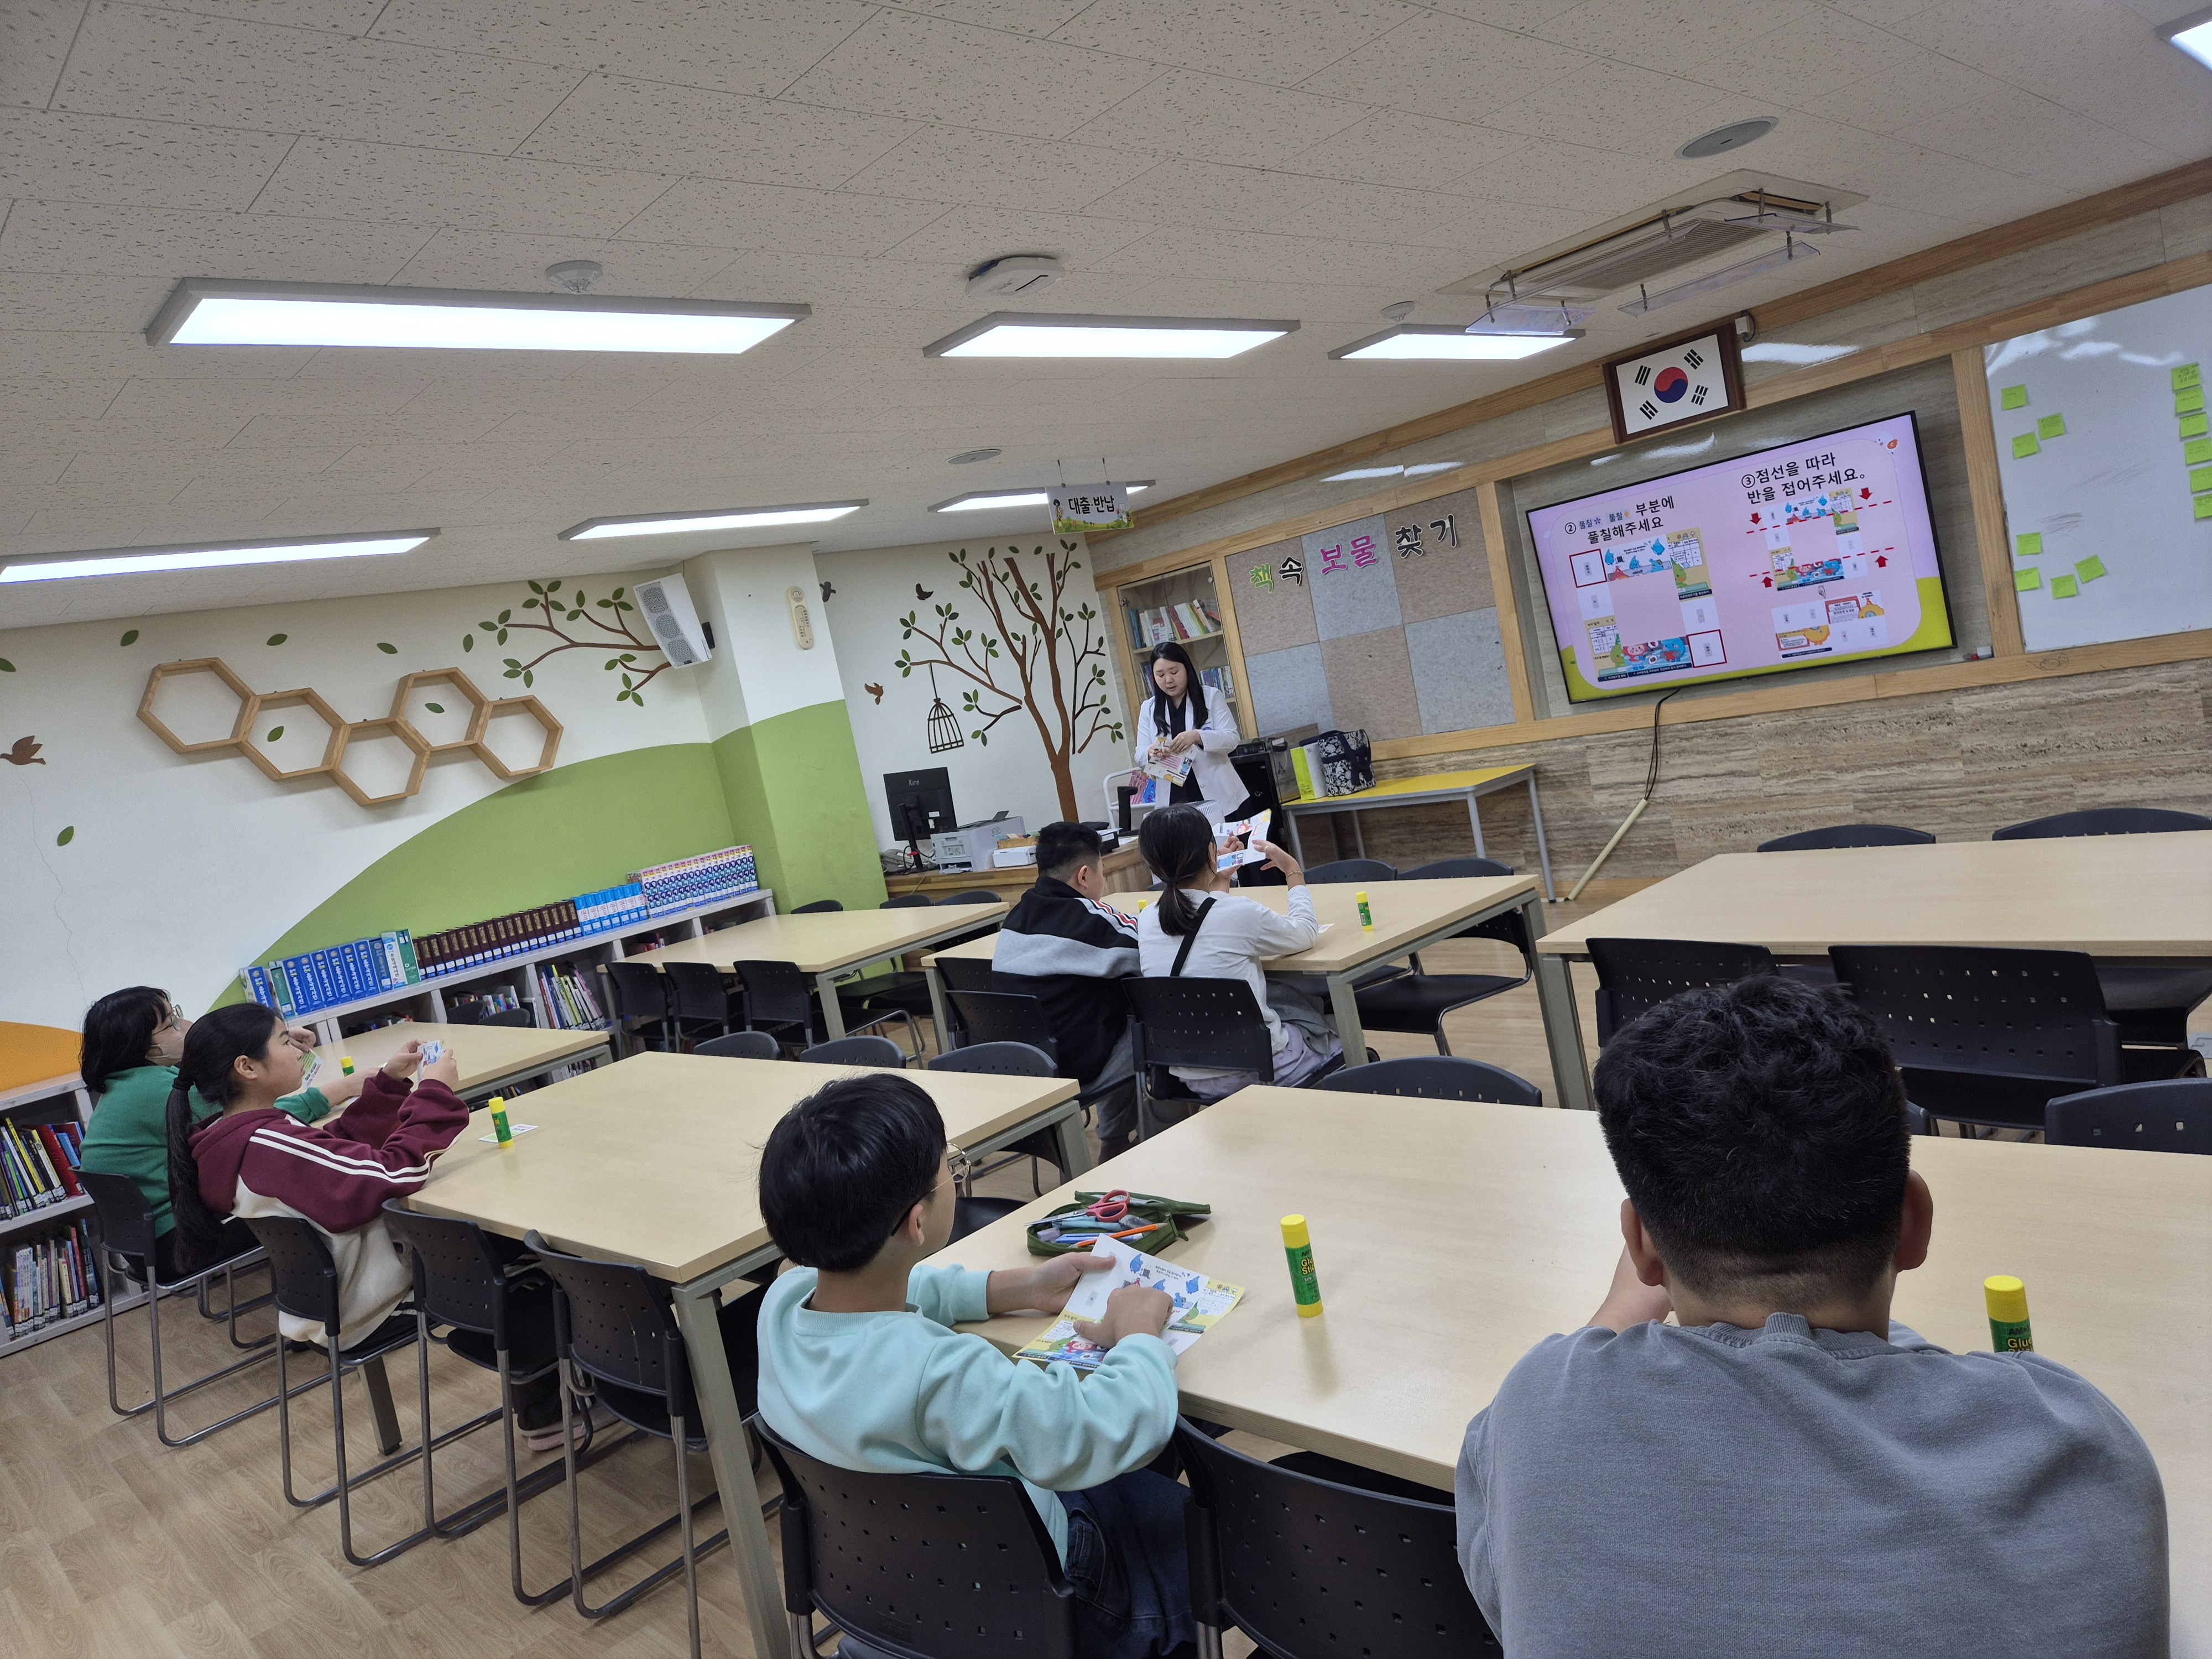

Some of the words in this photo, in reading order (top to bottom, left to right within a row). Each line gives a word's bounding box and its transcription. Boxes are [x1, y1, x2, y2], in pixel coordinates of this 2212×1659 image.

[1806, 452, 1835, 471] 따라
[1747, 486, 1776, 505] 반을
[1579, 519, 1593, 530] 풀칠
[1609, 512, 1624, 523] 풀칠
[1636, 495, 1674, 517] 부분에
[1587, 516, 1663, 545] 풀칠해주세요
[1250, 562, 1273, 593] 책
[1279, 556, 1303, 587] 속
[1319, 535, 1378, 576] 보물
[1394, 513, 1458, 560] 찾기
[2007, 1336, 2032, 1348] Glue
